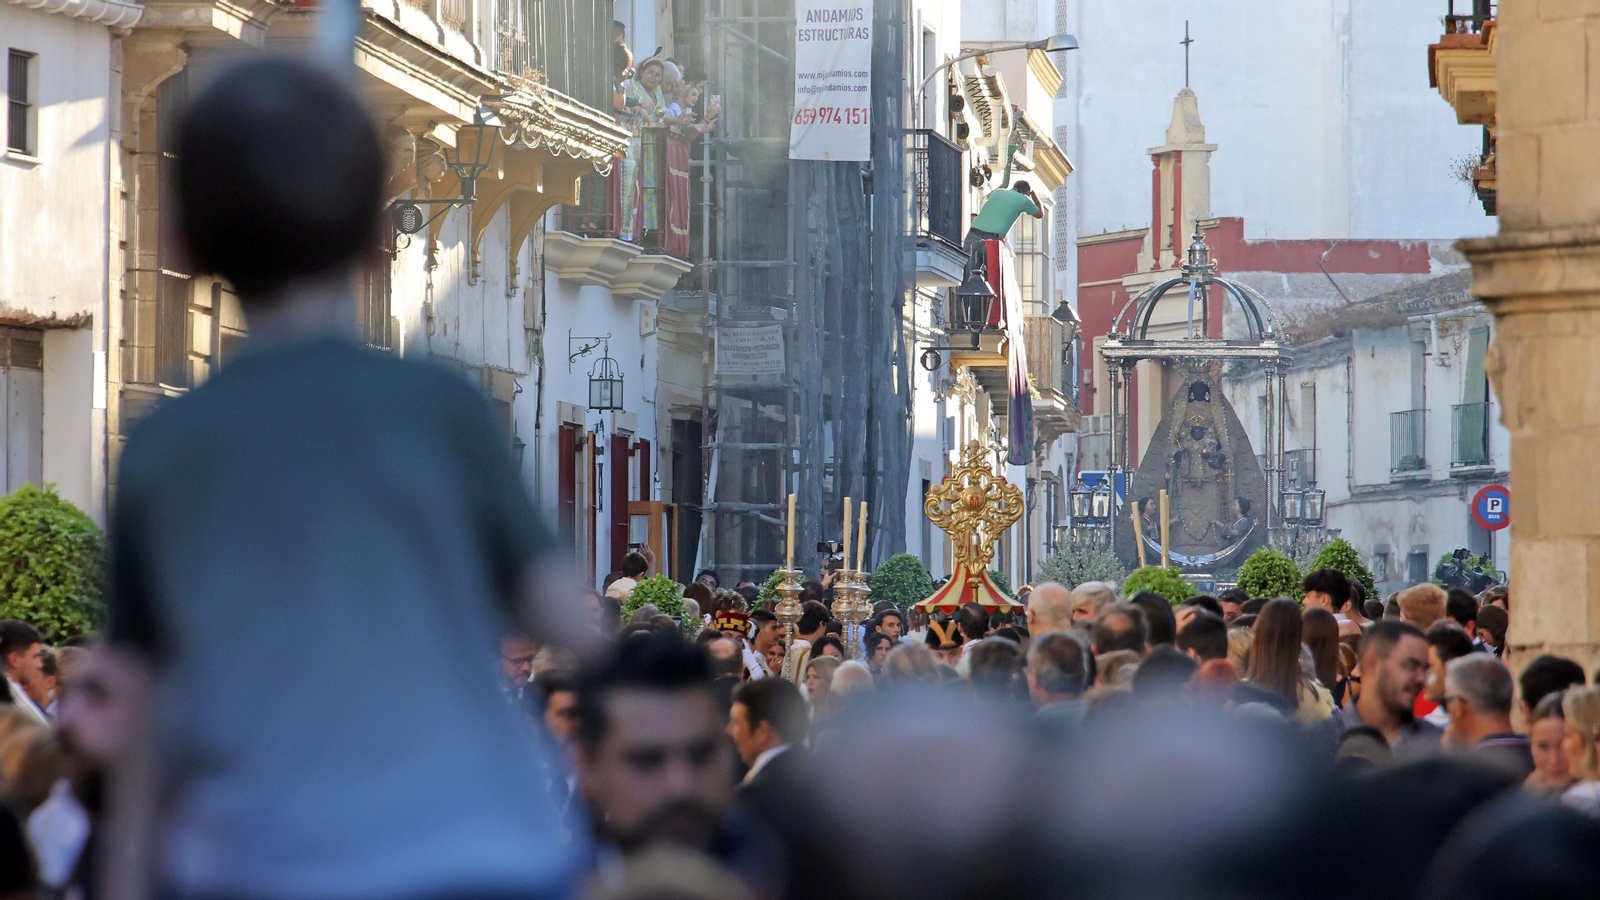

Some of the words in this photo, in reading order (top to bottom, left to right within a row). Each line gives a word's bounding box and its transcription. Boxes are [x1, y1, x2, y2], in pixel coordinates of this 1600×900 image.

[806, 8, 863, 23] ANDAMIOS
[798, 27, 869, 42] ESTRUCTURAS
[797, 83, 868, 95] info@mndamios.com
[794, 108, 817, 125] 659
[819, 106, 842, 124] 974
[845, 107, 867, 125] 151
[1491, 500, 1500, 510] P
